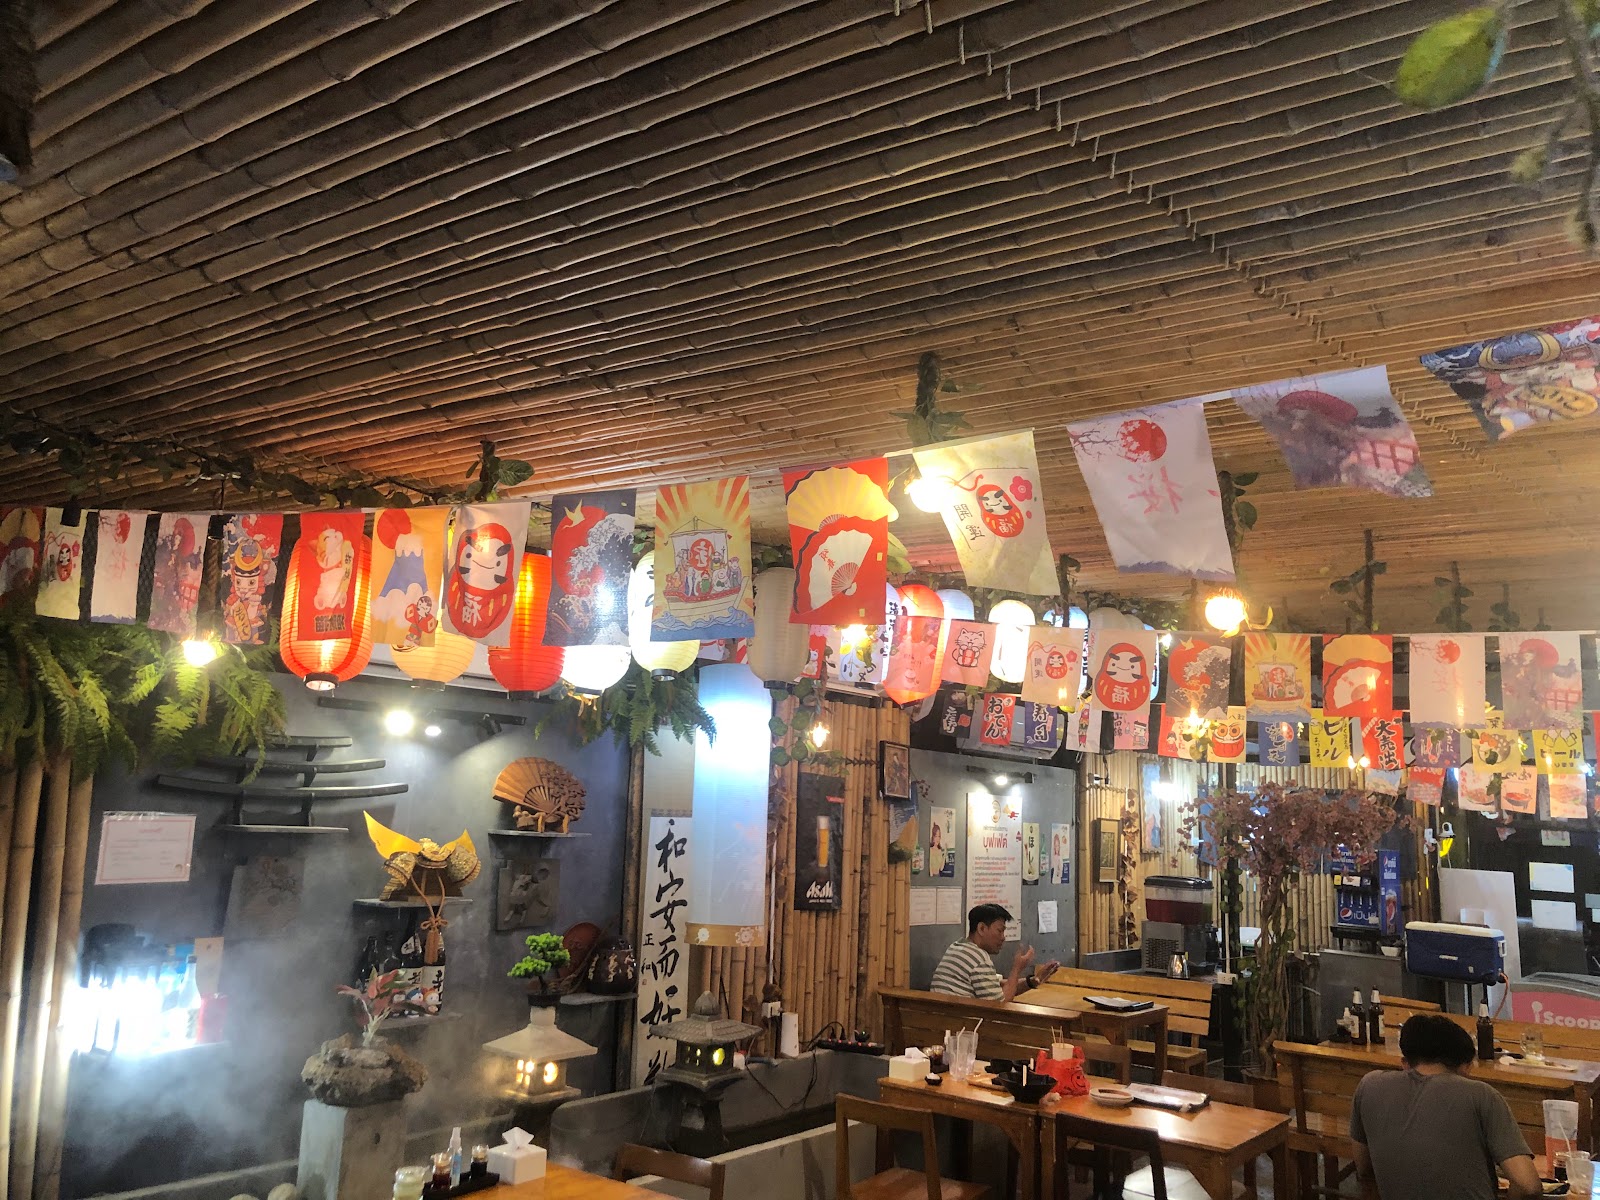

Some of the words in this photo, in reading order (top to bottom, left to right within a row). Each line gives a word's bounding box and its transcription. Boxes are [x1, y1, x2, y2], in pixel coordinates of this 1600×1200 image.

[985, 697, 1006, 739] おでん
[1323, 716, 1345, 761] ビール
[806, 880, 834, 899] Asahi
